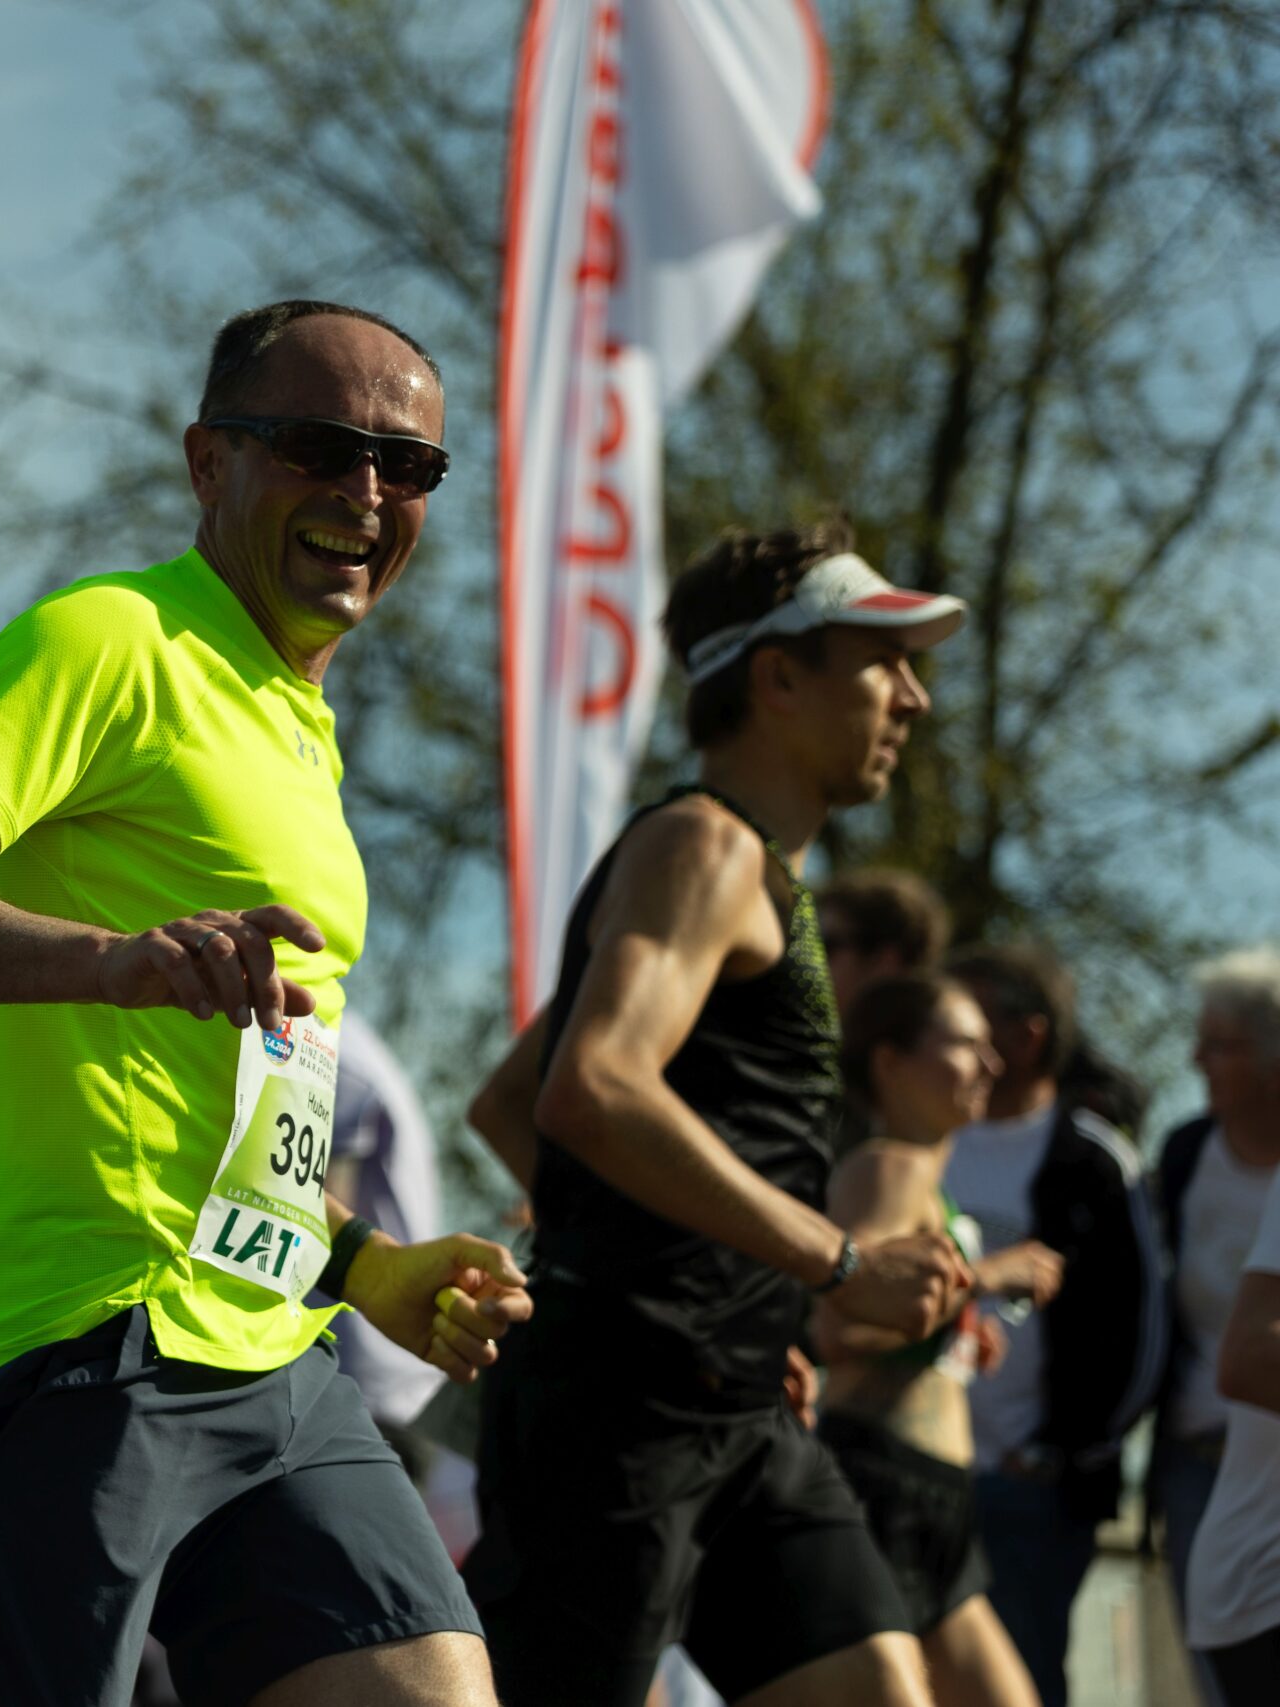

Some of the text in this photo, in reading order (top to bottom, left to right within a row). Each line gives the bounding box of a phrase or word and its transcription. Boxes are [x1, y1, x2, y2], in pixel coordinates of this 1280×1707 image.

[264, 1036, 292, 1056] 7.4.2024
[300, 1043, 318, 1060] LINZ
[319, 1054, 335, 1074] DONA
[298, 1056, 335, 1089] MARATHO
[270, 1112, 326, 1199] 394
[227, 1186, 301, 1222] LAT NITROGEN
